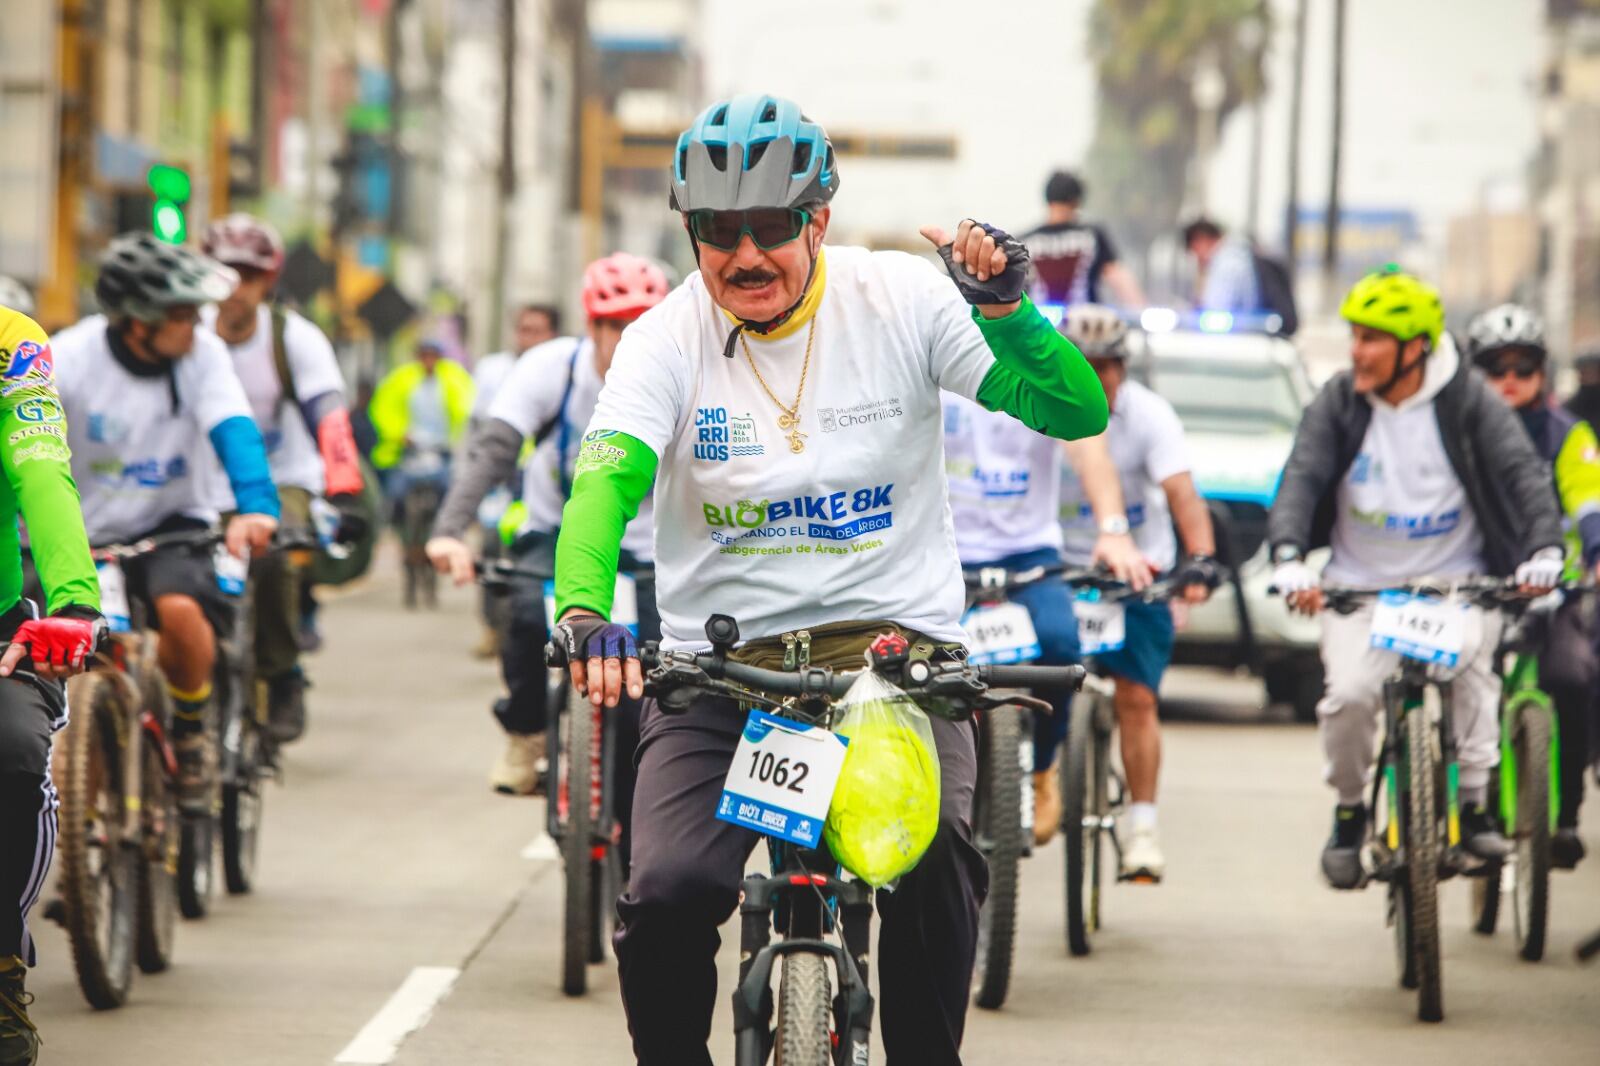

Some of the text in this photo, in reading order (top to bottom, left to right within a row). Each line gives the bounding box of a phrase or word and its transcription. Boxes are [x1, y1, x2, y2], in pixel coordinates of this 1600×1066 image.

[694, 407, 727, 426] CHO
[838, 407, 903, 428] Chorrillos
[698, 426, 729, 443] RRI
[694, 443, 729, 462] LLOS
[851, 483, 895, 513] 8K
[790, 526, 806, 536] EL
[811, 526, 832, 538] DÍA
[836, 527, 858, 539] DEL
[796, 543, 811, 554] de
[815, 541, 849, 555] Áreas
[748, 750, 809, 794] 1062
